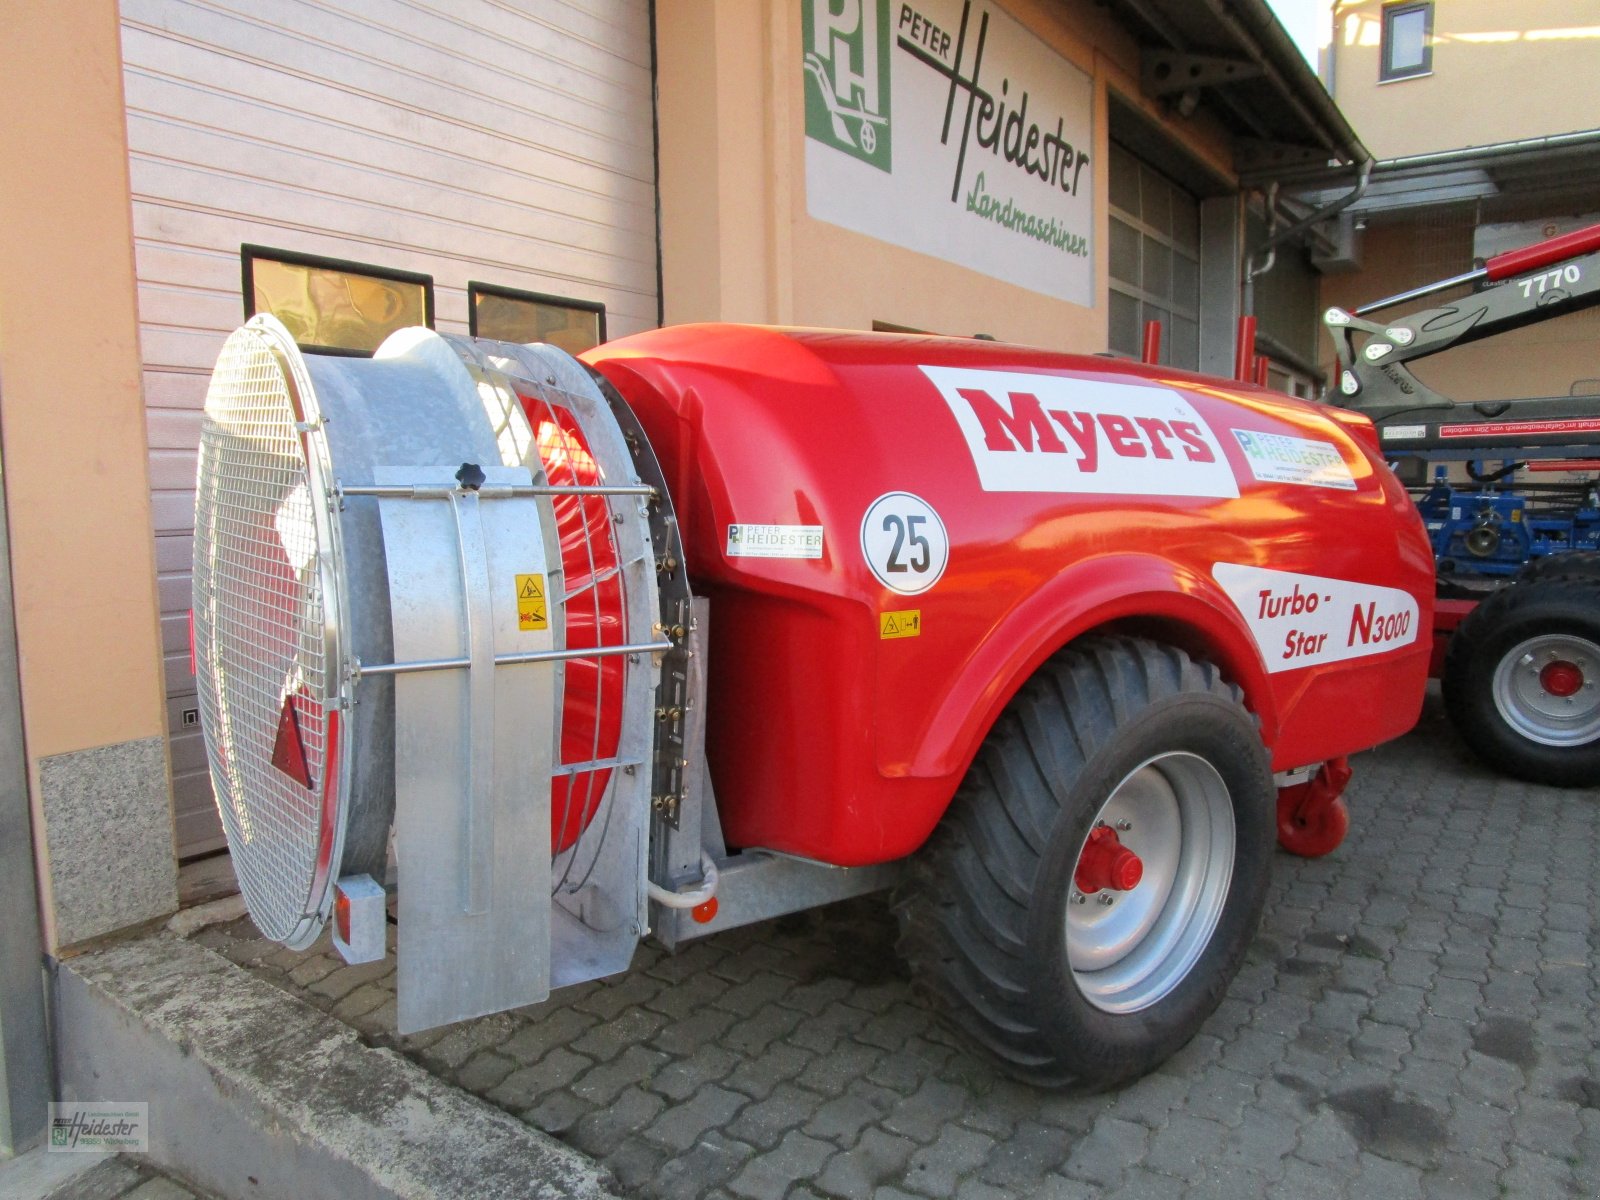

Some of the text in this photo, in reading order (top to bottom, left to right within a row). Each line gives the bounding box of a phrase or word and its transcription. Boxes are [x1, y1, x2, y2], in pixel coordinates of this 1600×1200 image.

[899, 3, 951, 60] PETER
[940, 0, 1090, 204] Heidester
[966, 171, 1089, 258] Landmaschinen
[1518, 264, 1581, 298] 7770
[955, 387, 1216, 473] Myers
[746, 535, 822, 546] HEIDESTER
[747, 526, 781, 535] PETER
[882, 513, 932, 574] 25
[1282, 628, 1329, 660] Star
[1347, 601, 1411, 648] N3000
